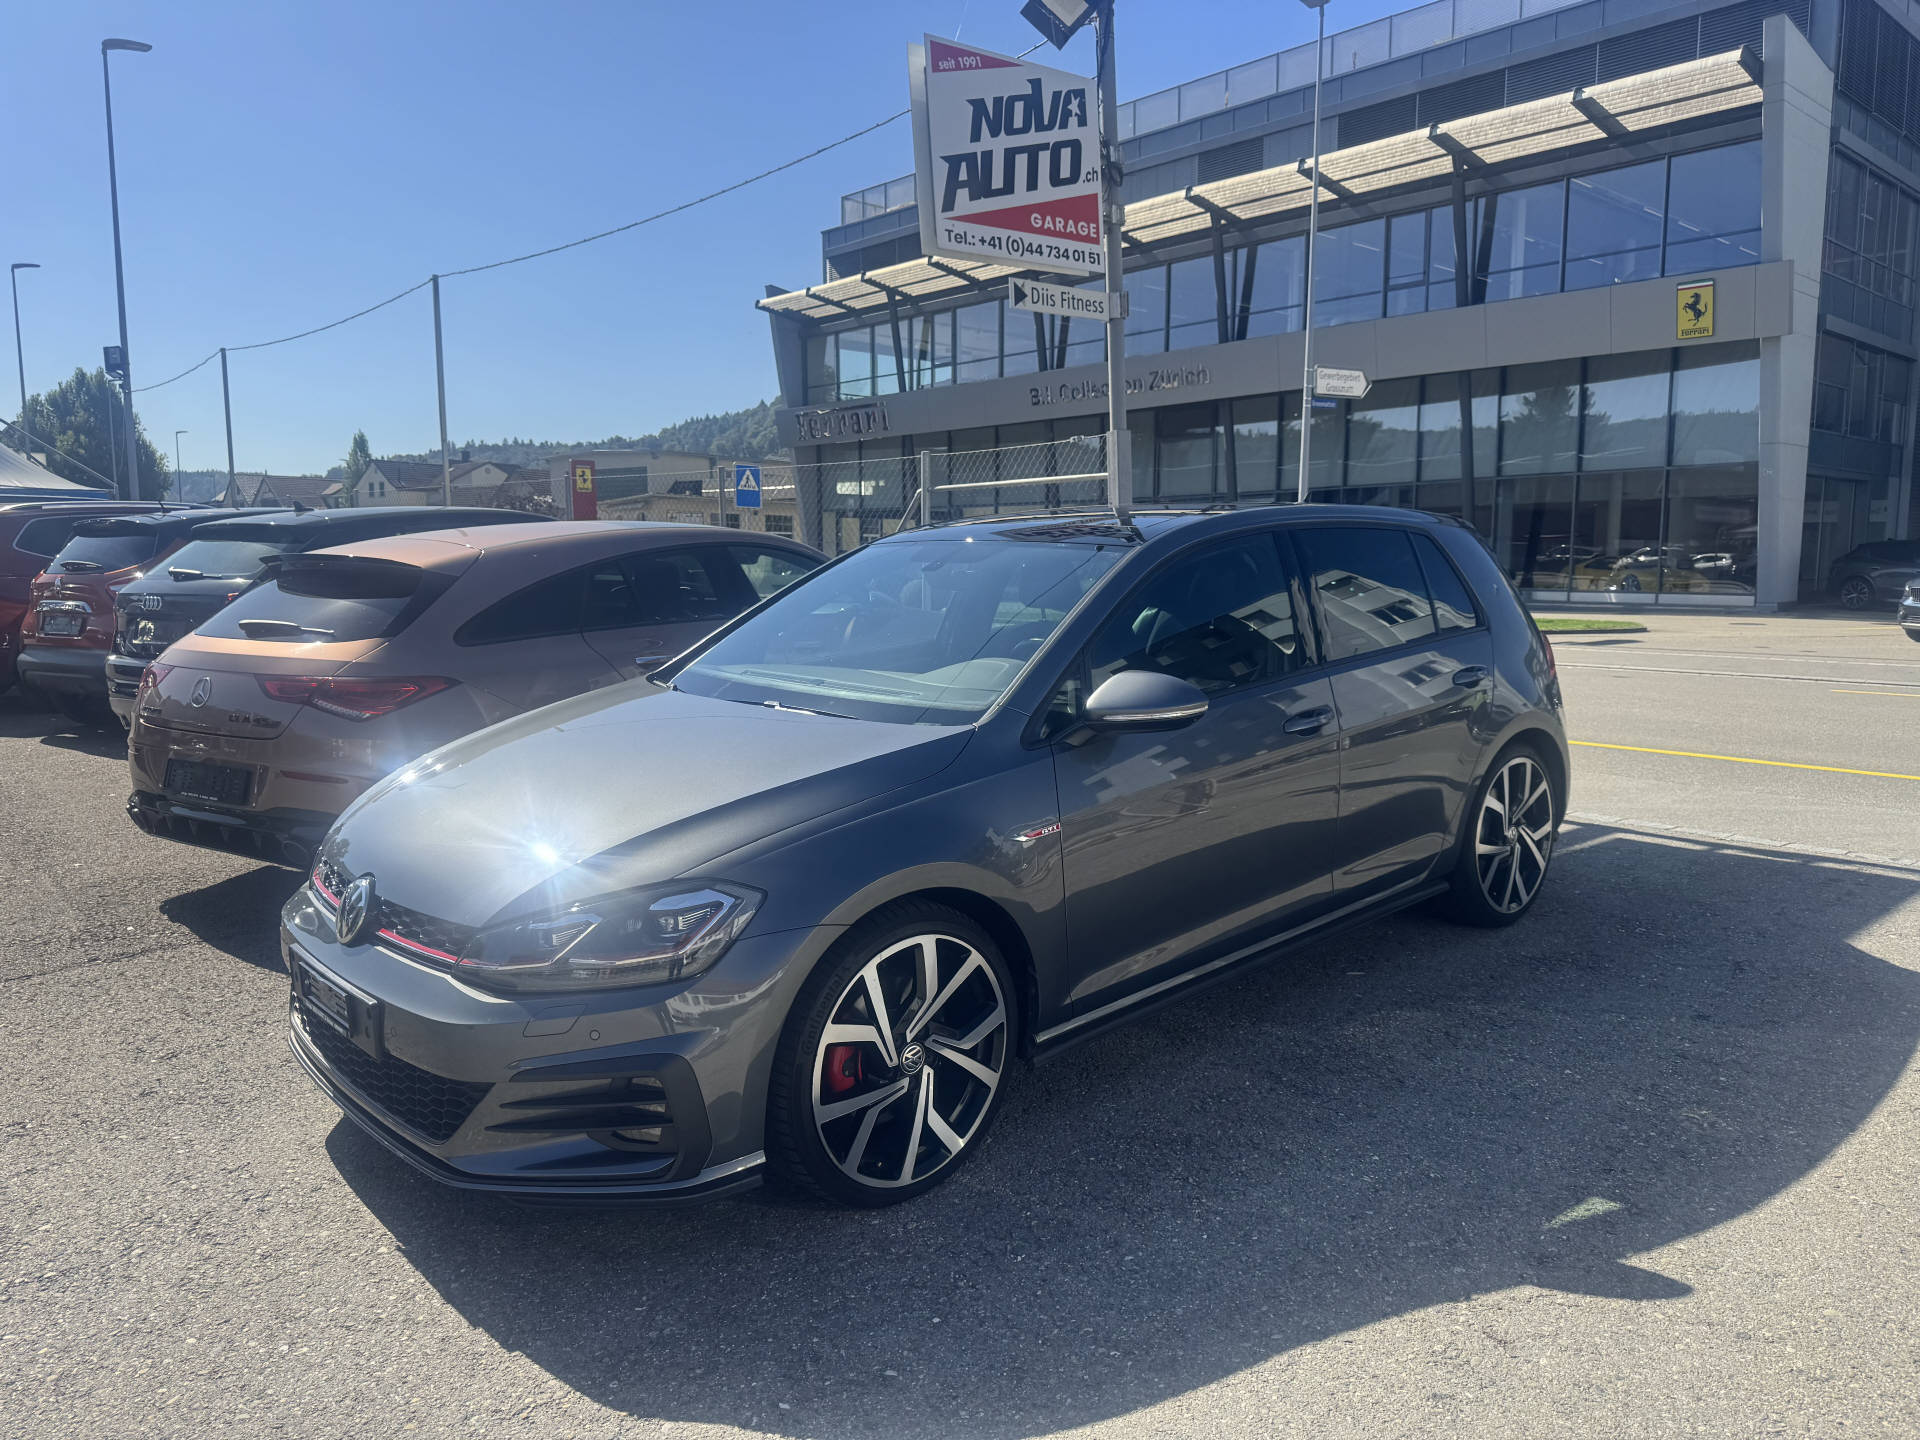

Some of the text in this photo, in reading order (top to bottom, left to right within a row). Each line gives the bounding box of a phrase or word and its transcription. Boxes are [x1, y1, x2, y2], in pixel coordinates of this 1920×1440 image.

[938, 56, 983, 70] seit 1991
[966, 78, 1087, 143] NOVA
[1030, 213, 1097, 238] GARAGE
[945, 229, 1100, 266] Tel.: +41 (0)44 734 01 51
[1031, 286, 1104, 315] Diis Fitness
[1059, 377, 1144, 401] Collecon
[1150, 365, 1211, 392] Zürich
[795, 401, 889, 441] Ferrari
